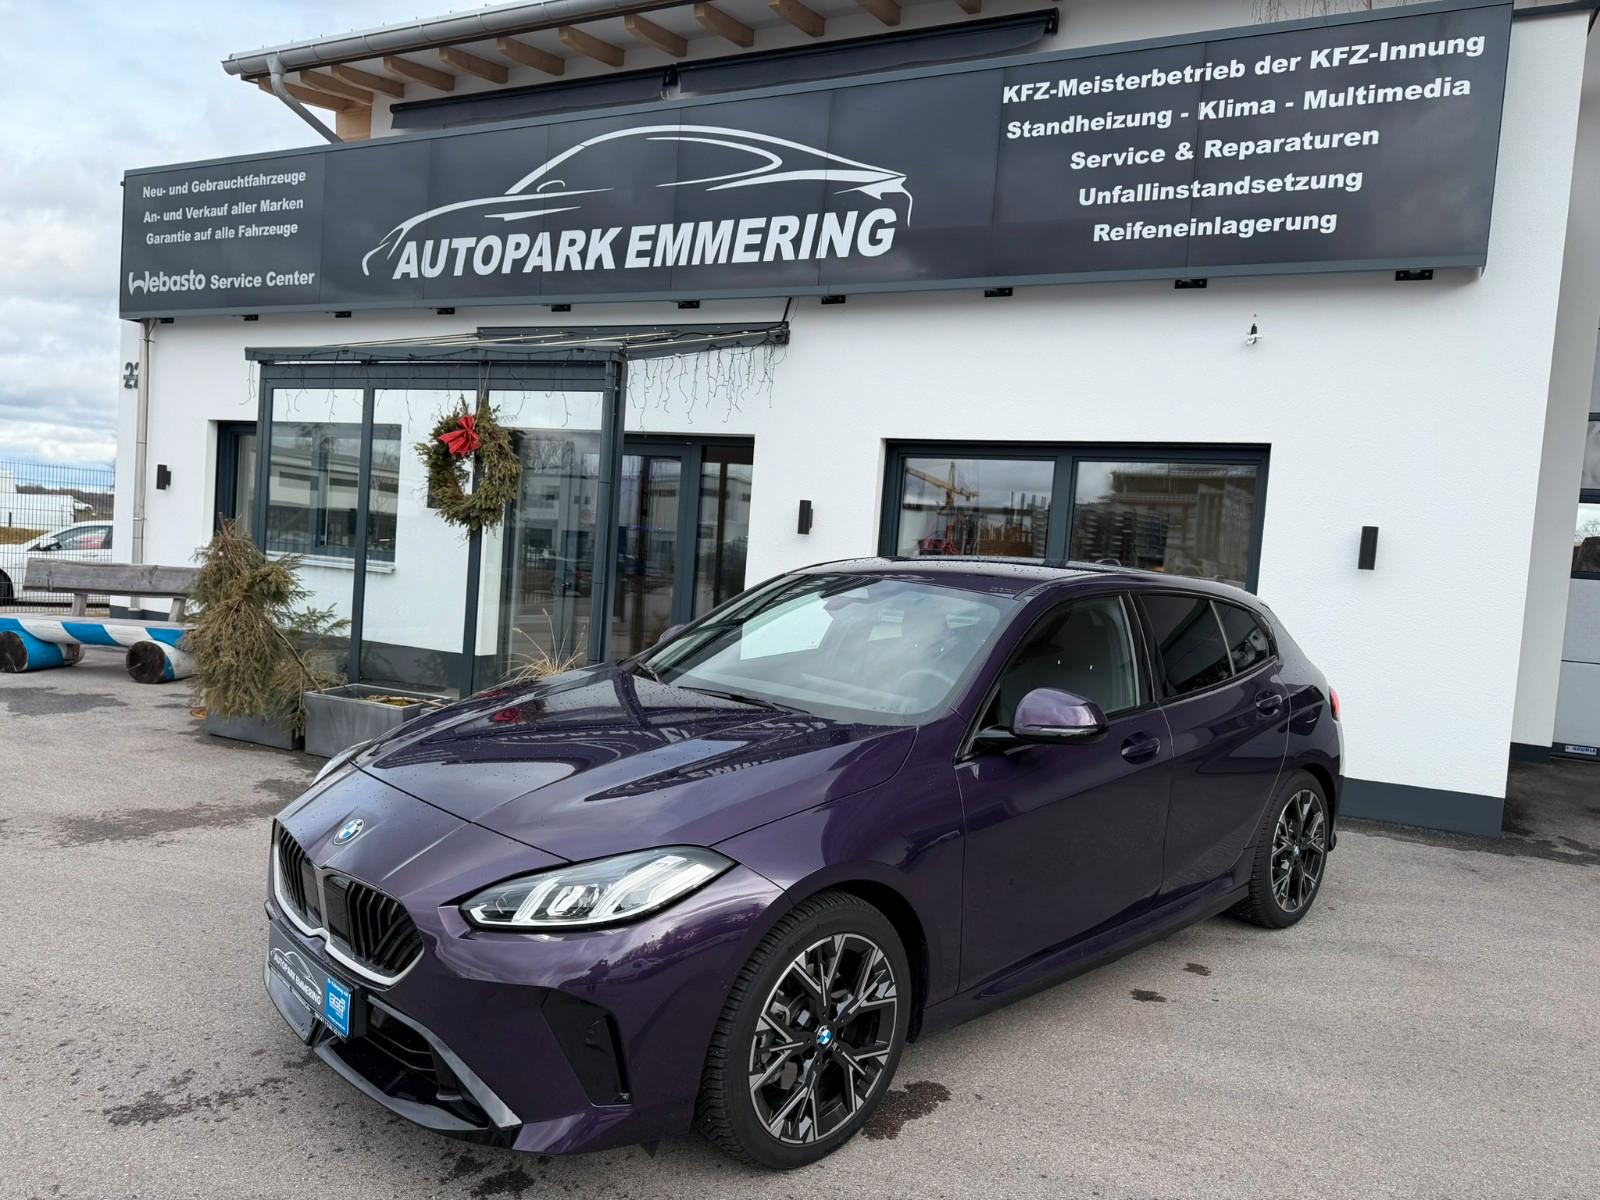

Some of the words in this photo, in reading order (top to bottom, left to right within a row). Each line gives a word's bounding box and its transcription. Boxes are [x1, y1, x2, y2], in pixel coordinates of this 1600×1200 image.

[1002, 61, 1245, 104] KFZ-Meisterbetrieb
[1254, 56, 1301, 75] der
[1309, 36, 1486, 70] KFZ-Innung
[1006, 108, 1173, 139] Standheizung
[1198, 97, 1276, 121] Klima
[1303, 77, 1471, 111] Multimedia
[1070, 147, 1166, 170] Service
[1175, 142, 1195, 161] &
[1204, 129, 1380, 161] Reparaturen
[143, 186, 166, 198] Neu-
[169, 182, 189, 196] und
[191, 171, 306, 193] Gebrauchtfahrzeuge
[1078, 171, 1364, 206] Unfallinstandsetzung
[143, 211, 161, 223] An-
[163, 208, 182, 221] und
[185, 203, 228, 219] Verkauf
[231, 201, 257, 215] aller
[260, 198, 304, 212] Marken
[146, 230, 191, 245] Garantie
[194, 228, 212, 242] auf
[215, 226, 235, 239] alle
[238, 223, 298, 238] Fahrzeuge
[392, 227, 622, 280] AUTOPARK
[624, 208, 897, 269] EMMERING
[1093, 212, 1338, 243] Reifeneinlagerung
[128, 269, 206, 295] Webasto
[210, 273, 262, 289] Service
[266, 270, 316, 287] Center
